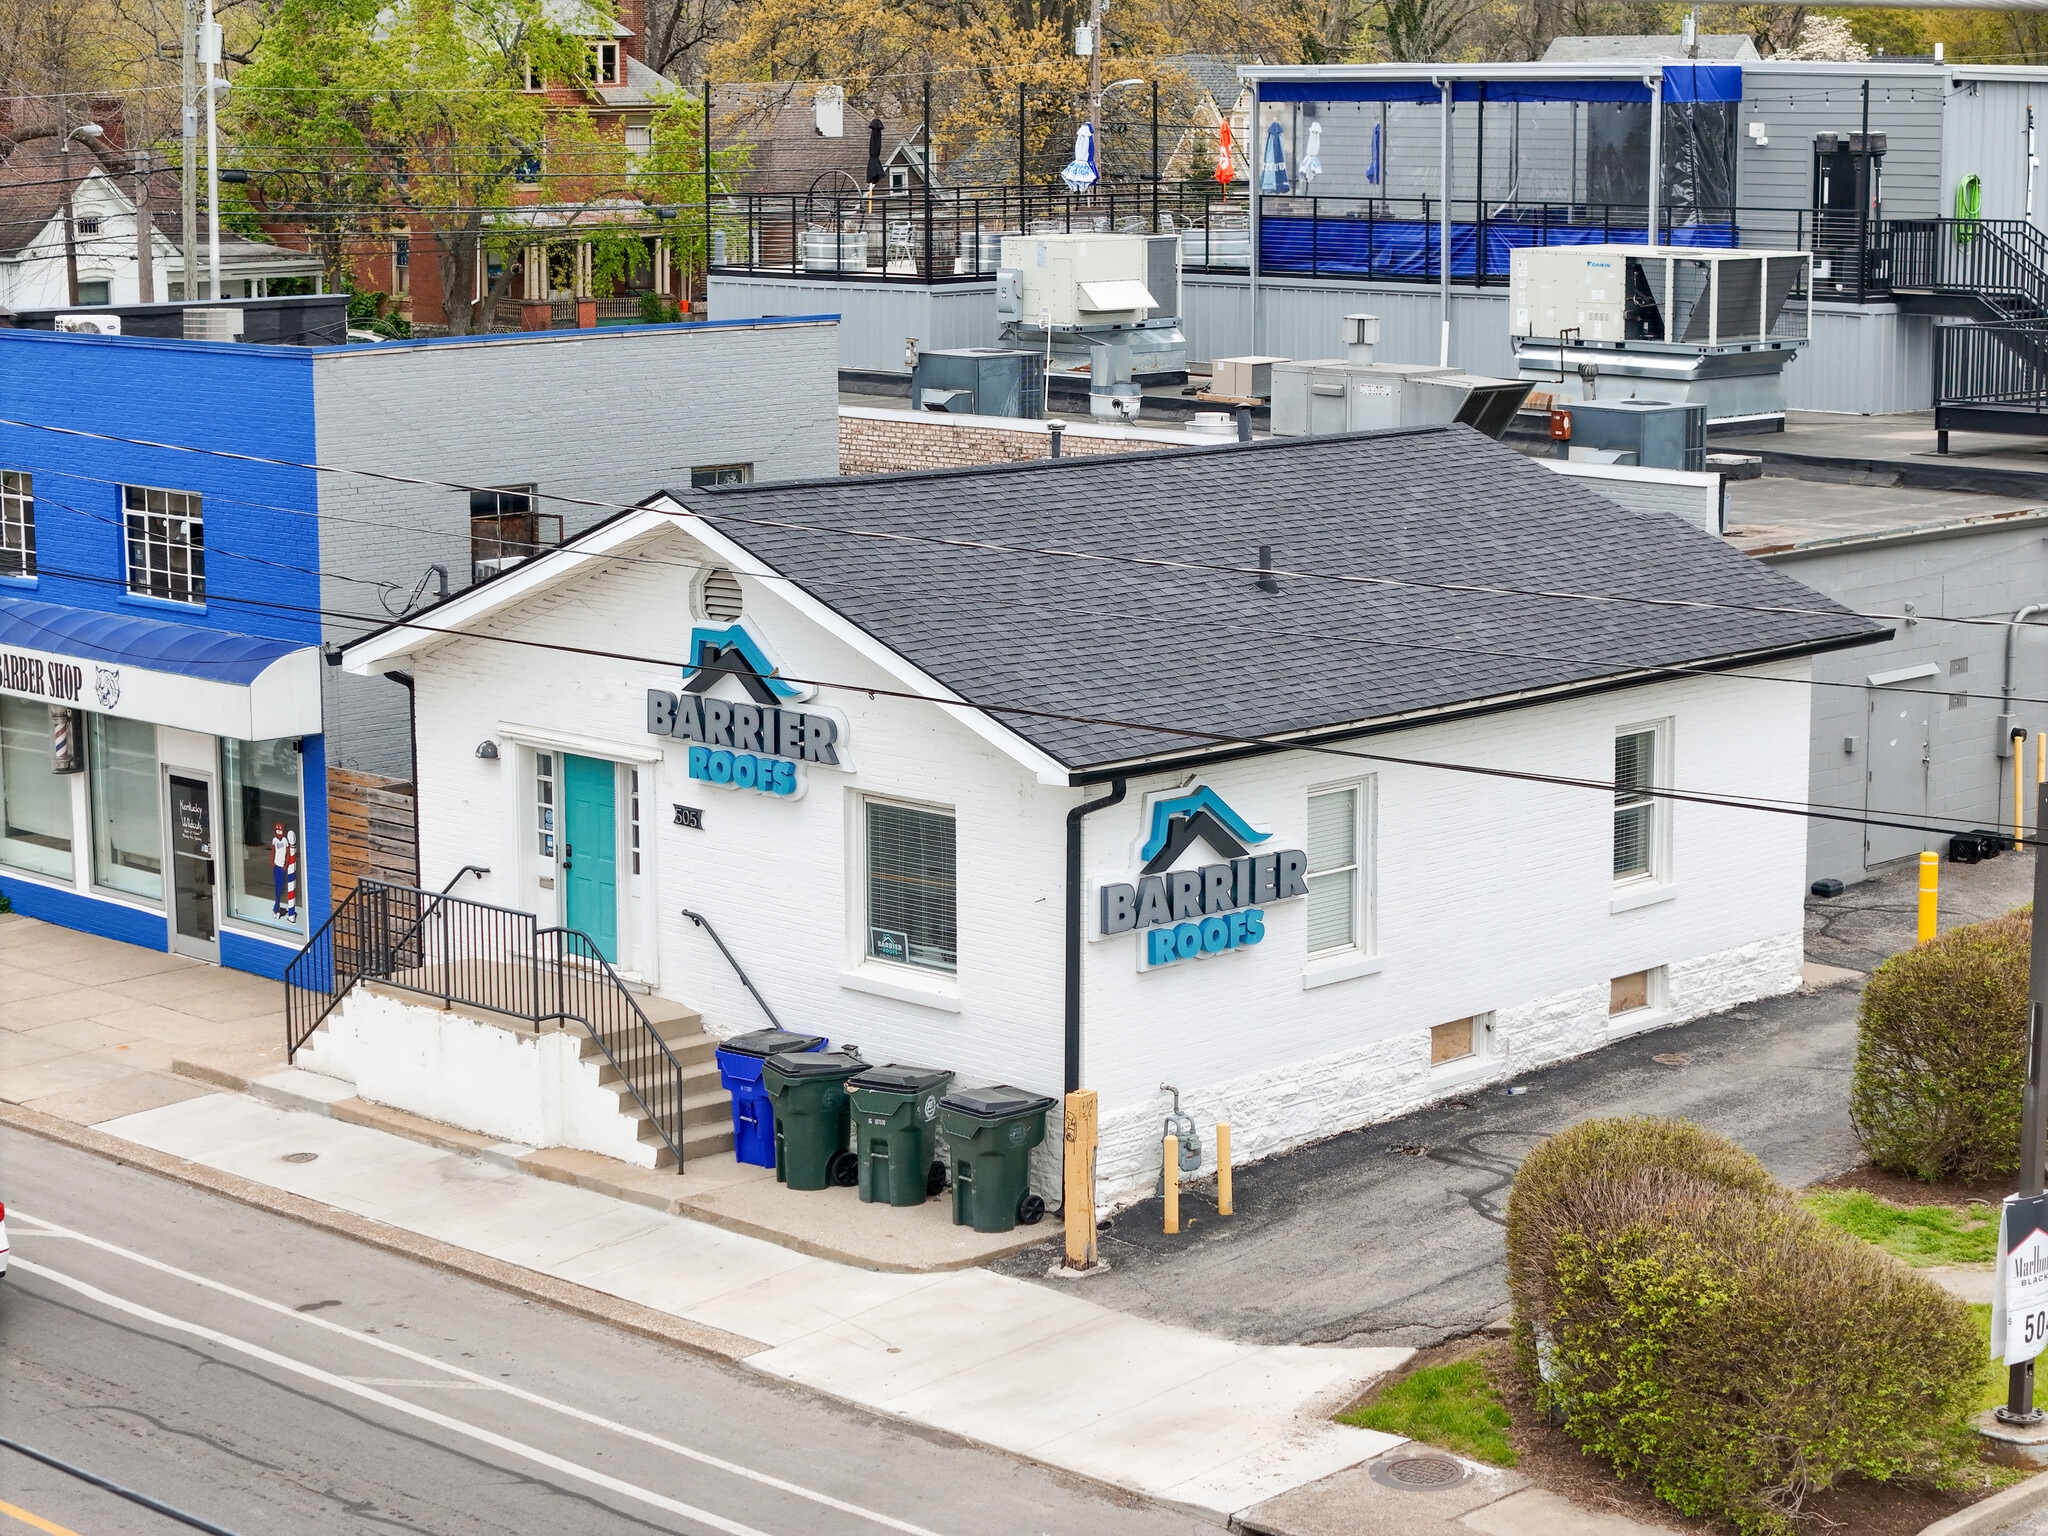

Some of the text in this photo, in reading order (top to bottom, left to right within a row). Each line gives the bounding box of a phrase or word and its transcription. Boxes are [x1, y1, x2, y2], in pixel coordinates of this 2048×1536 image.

[48, 661, 82, 702] SHOP
[648, 689, 839, 765] BARRIER
[689, 746, 796, 795] ROOFS
[180, 799, 202, 819] Kentucky
[675, 808, 697, 827] 505
[1101, 849, 1309, 935] BARRIER
[877, 940, 902, 951] BARRIER
[1148, 909, 1265, 965] ROOFS
[2014, 1245, 2048, 1278] Marlbo
[2025, 1310, 2048, 1344] 50
